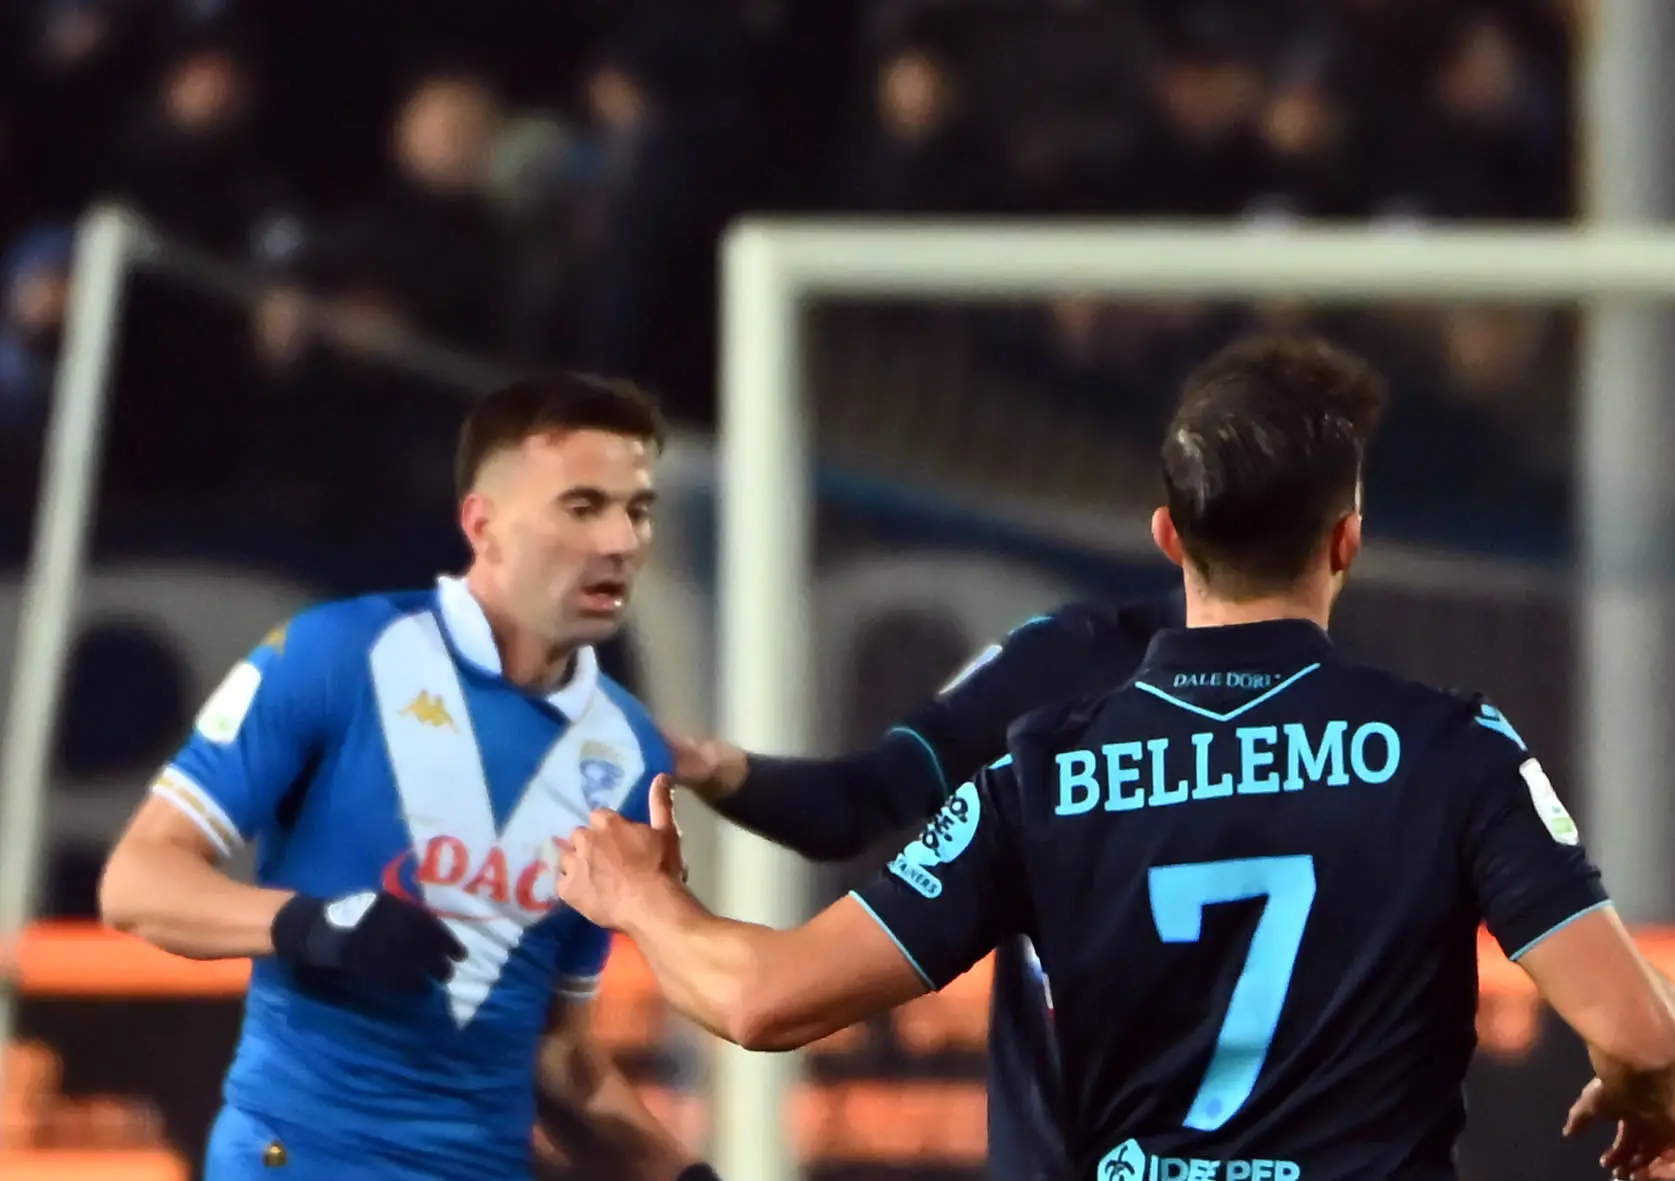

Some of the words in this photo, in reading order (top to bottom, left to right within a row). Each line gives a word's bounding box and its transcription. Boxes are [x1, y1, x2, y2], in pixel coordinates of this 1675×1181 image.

[1173, 672, 1222, 688] DALE
[1055, 720, 1401, 816] BELLEMO
[416, 834, 559, 912] DAC
[1148, 854, 1317, 1131] 7
